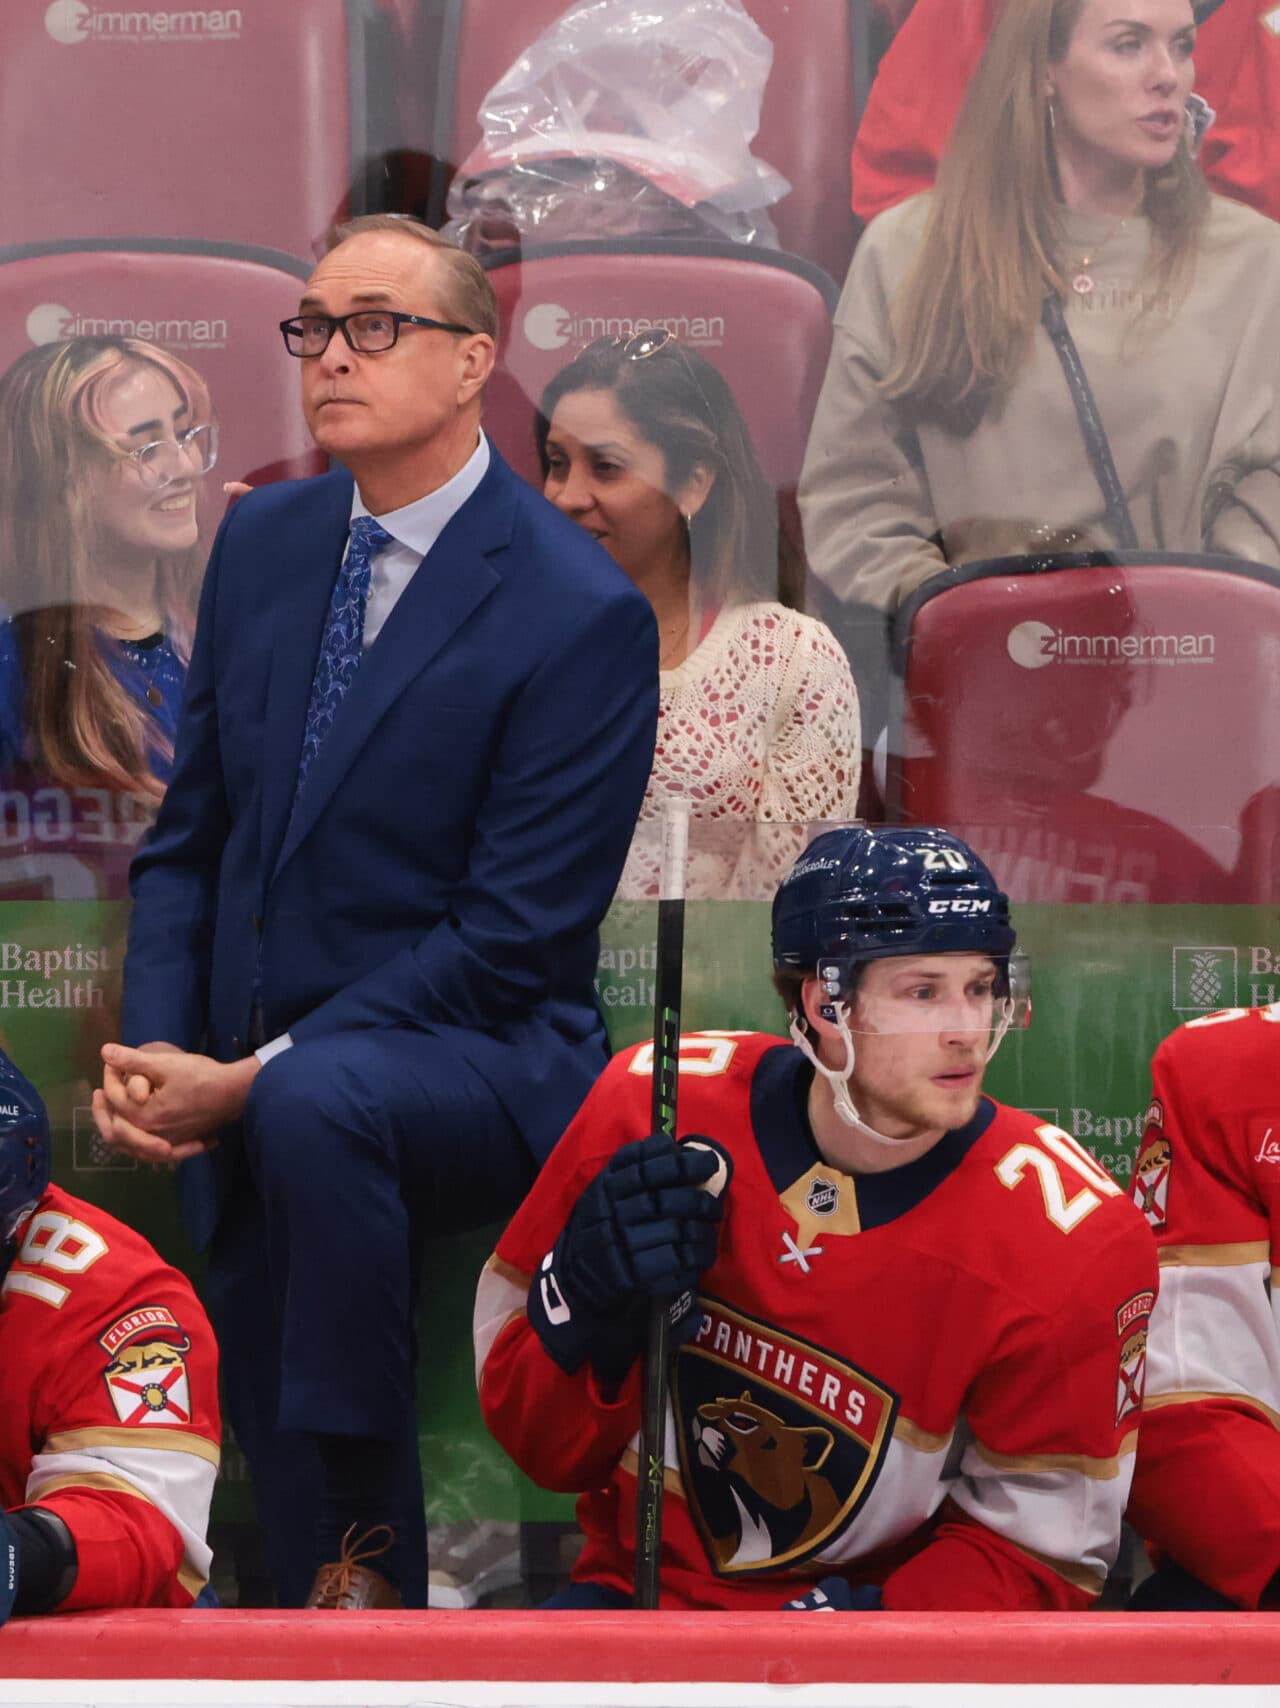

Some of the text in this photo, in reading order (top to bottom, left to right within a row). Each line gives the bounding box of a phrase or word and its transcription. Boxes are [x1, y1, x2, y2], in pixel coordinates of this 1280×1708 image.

[75, 7, 242, 33] zimmerman
[58, 313, 228, 340] zimmerman
[1039, 628, 1215, 657] zimmerman
[915, 848, 969, 871] 20
[928, 899, 992, 915] CCM
[0, 943, 111, 980] Baptist
[0, 980, 105, 1008] Health
[993, 1123, 1125, 1235] 20
[1, 1210, 111, 1310] 18
[107, 1310, 168, 1344] FLORIDA
[695, 1313, 867, 1427] PANTHERS
